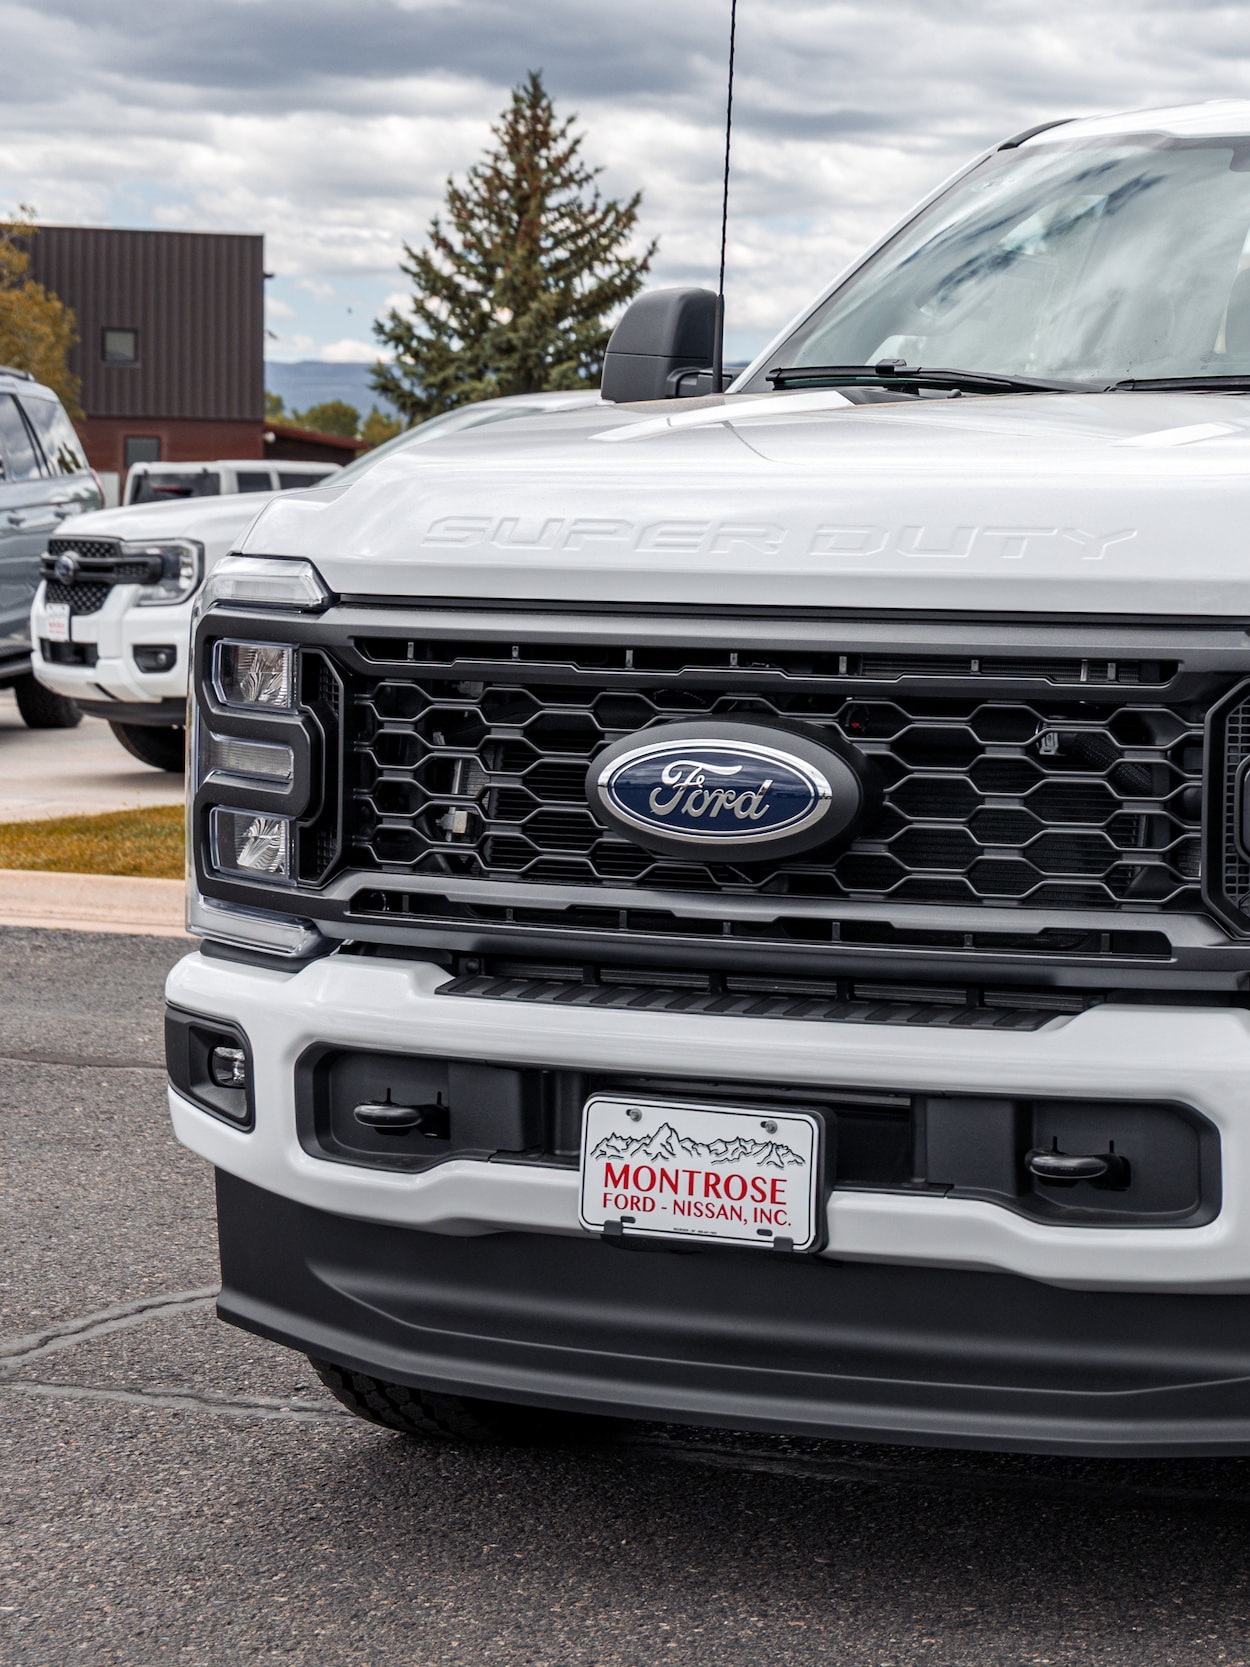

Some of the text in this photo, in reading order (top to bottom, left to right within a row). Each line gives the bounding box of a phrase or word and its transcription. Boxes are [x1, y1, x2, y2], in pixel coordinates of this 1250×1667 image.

[420, 515, 1138, 561] SUPER DUTY
[649, 759, 774, 820] Ford
[604, 1162, 788, 1205] MONTROSE
[602, 1192, 656, 1213] FORD
[673, 1199, 748, 1225] NISSAN,
[753, 1207, 792, 1227] INC.
